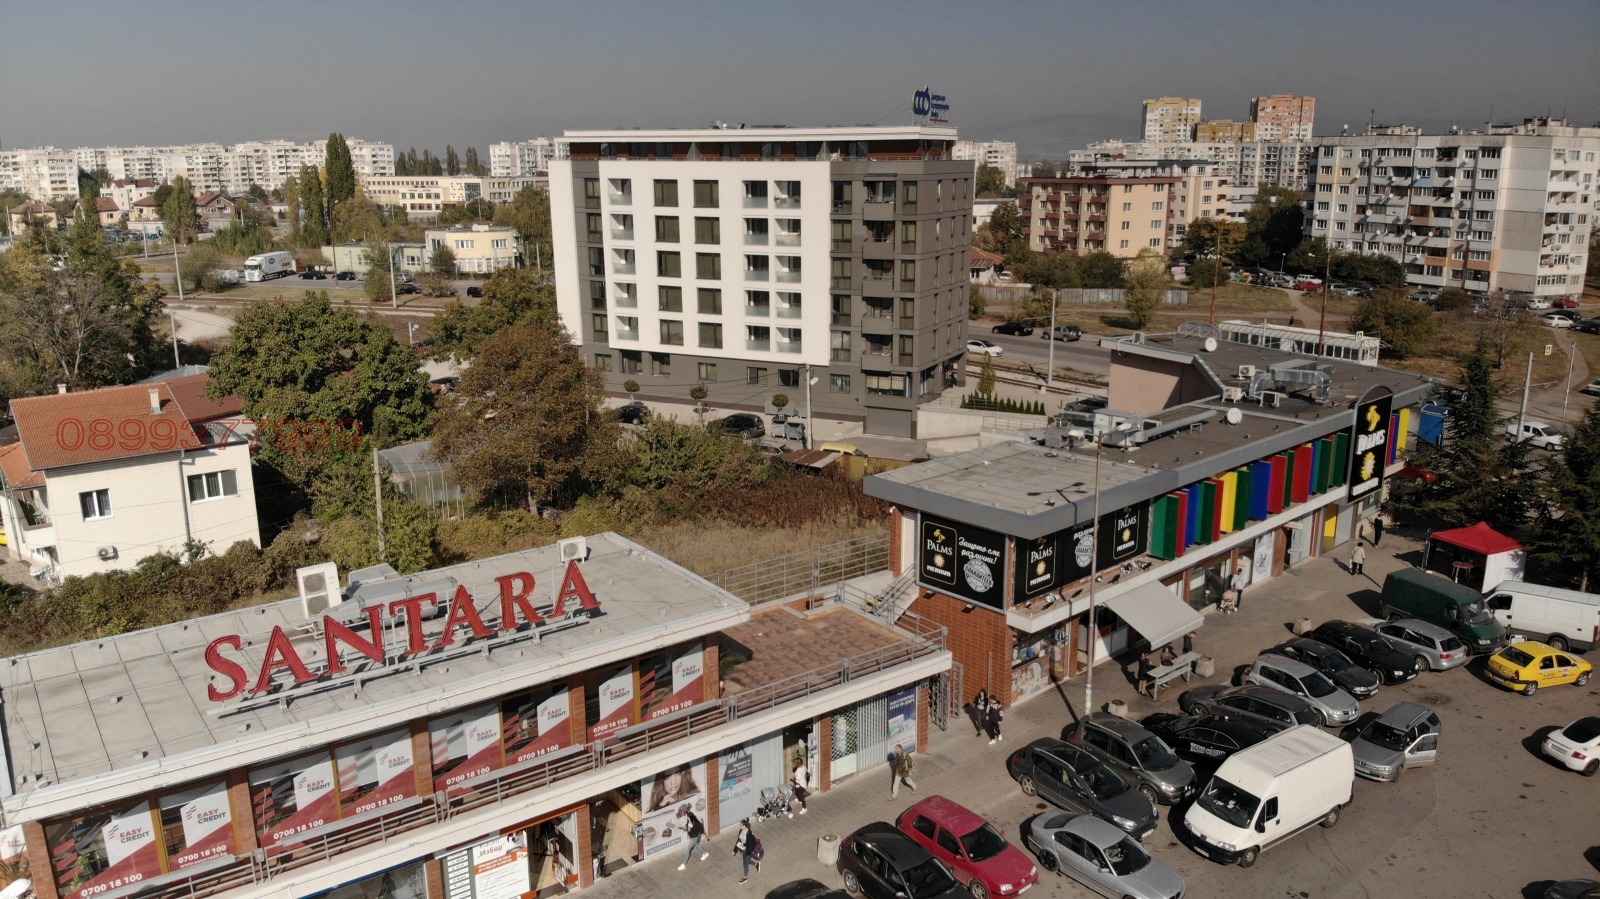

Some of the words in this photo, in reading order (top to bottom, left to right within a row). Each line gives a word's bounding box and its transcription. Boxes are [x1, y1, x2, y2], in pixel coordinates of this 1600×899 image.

[1356, 429, 1386, 455] PALMS
[1117, 515, 1137, 531] PALMS
[927, 538, 953, 556] PALMS
[1030, 546, 1053, 563] PALMS
[927, 565, 952, 577] MERKUR
[1029, 573, 1051, 586] MERKUR
[205, 559, 602, 702] SANTARA
[682, 668, 700, 677] CREDIT
[610, 687, 626, 695] EASY
[610, 690, 631, 700] CREDIT
[652, 708, 669, 718] 0700
[680, 699, 693, 709] 100
[548, 711, 567, 720] CREDIT
[593, 724, 608, 733] 0700
[617, 717, 628, 726] 100
[477, 729, 493, 737] EASY
[477, 732, 498, 742] CREDIT
[388, 755, 405, 763] EASY
[518, 752, 535, 762] 0700
[537, 748, 546, 756] 18
[546, 744, 559, 753] 100
[389, 758, 410, 768] CREDIT
[446, 774, 465, 785] 0700
[466, 770, 475, 778] 18
[476, 766, 490, 775] 100
[307, 779, 325, 787] EASY
[307, 782, 331, 792] CREDIT
[356, 802, 376, 814] 0700
[378, 798, 388, 807] 18
[389, 794, 404, 803] 100
[198, 808, 219, 819] EASY
[198, 812, 227, 824] CREDIT
[120, 827, 142, 838] EASY
[273, 828, 295, 839] 0700
[296, 823, 307, 831] 18
[308, 819, 324, 828] 100
[121, 831, 150, 843] CREDIT
[178, 853, 199, 864] 0700
[201, 849, 211, 857] 18
[212, 845, 227, 854] 100
[81, 884, 107, 897] 0700
[109, 879, 122, 889] 18
[125, 873, 143, 884] 100
